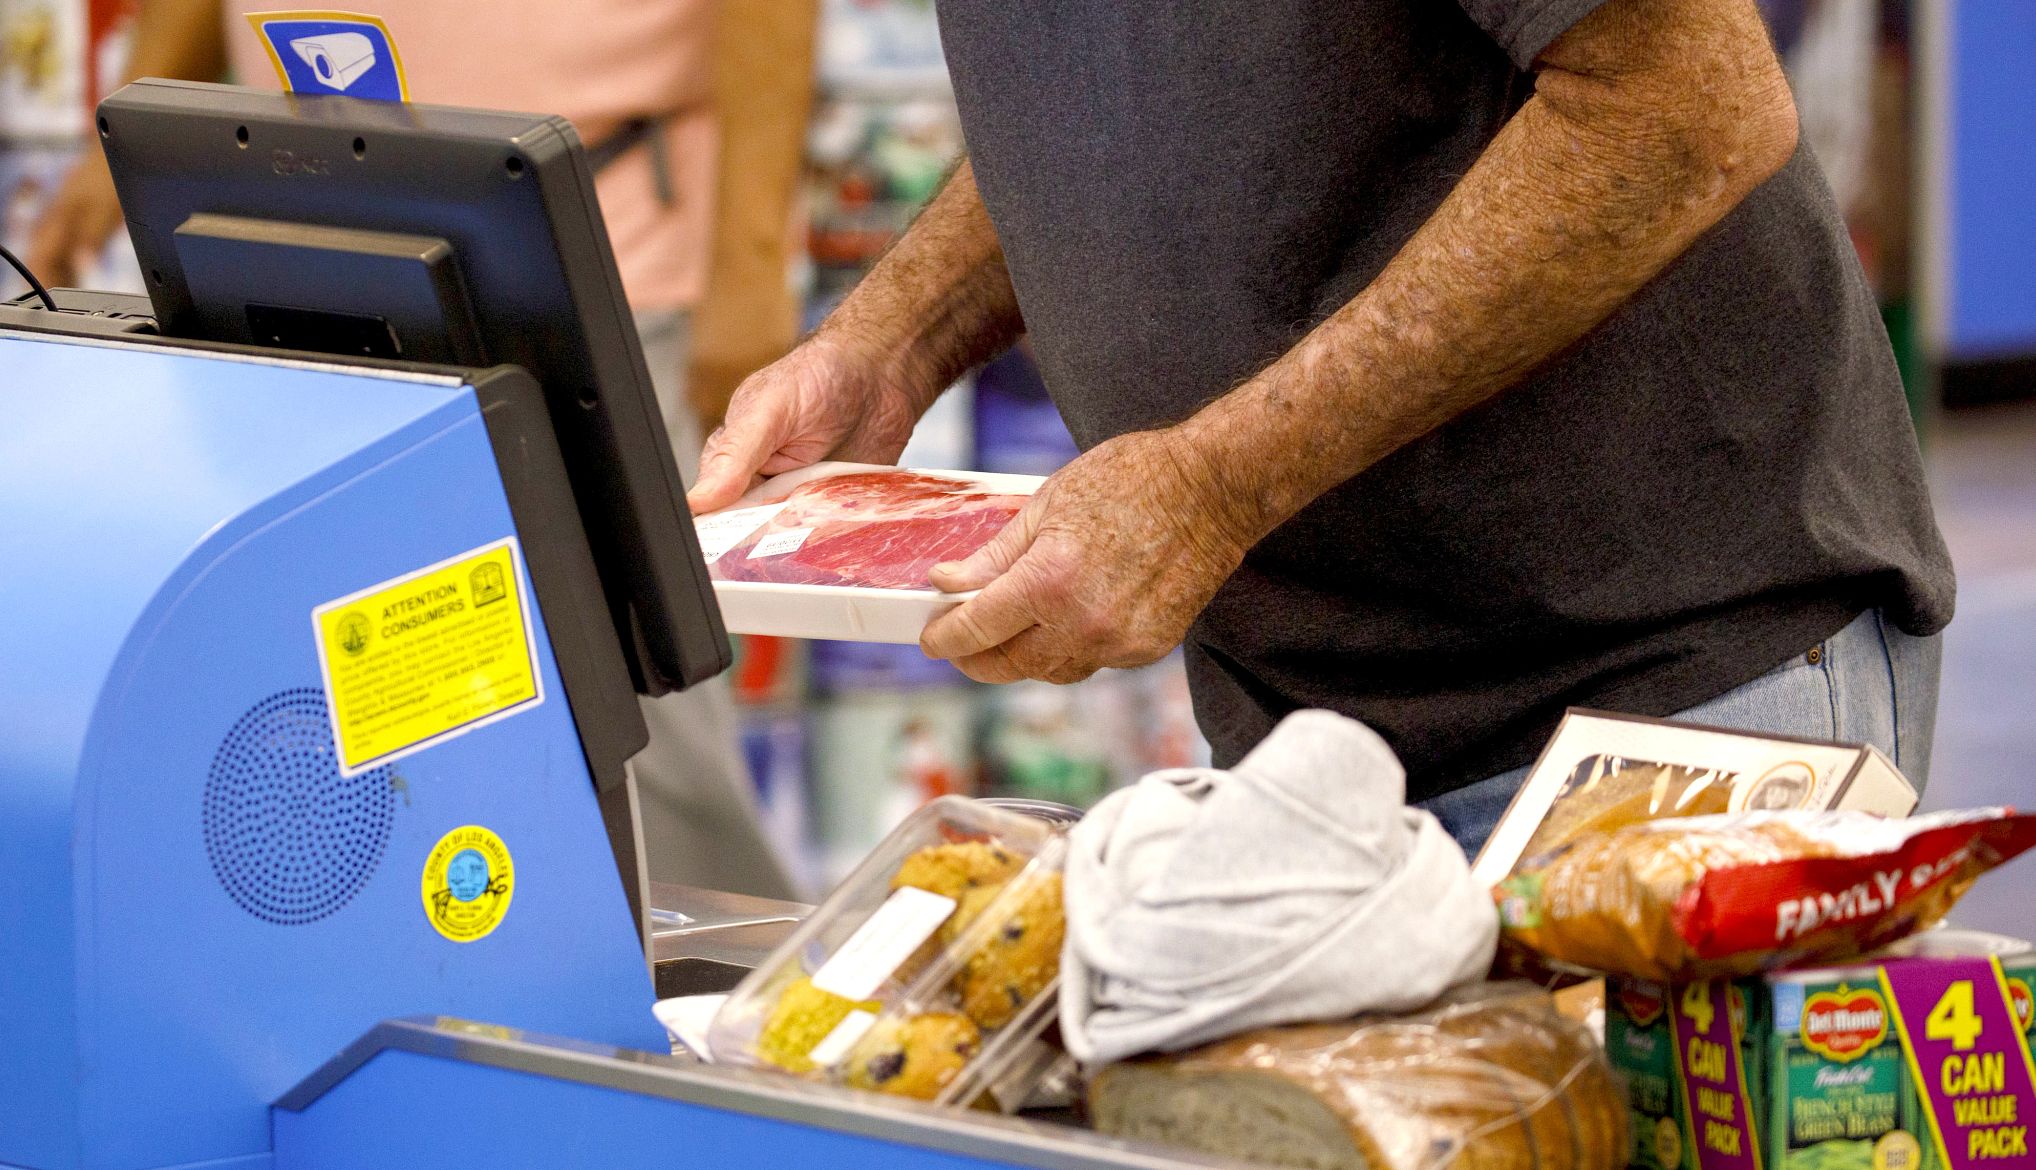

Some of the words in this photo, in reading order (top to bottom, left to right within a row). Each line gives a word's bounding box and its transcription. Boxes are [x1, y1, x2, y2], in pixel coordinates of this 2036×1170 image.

[380, 581, 457, 620] ATTENTION
[380, 597, 465, 639] CONSUMERS
[427, 841, 450, 880] COUNTY
[451, 832, 463, 845] OF
[466, 831, 483, 843] LOS
[485, 837, 508, 877] ANGELES
[1775, 868, 1902, 941] FAMILY
[1682, 979, 1714, 1034] 4
[1808, 1010, 1832, 1034] Del
[1834, 1008, 1883, 1032] Monte
[1926, 980, 1983, 1051] 4
[1688, 1036, 1727, 1085] CAN
[1941, 1052, 2005, 1097] CAN
[1696, 1087, 1735, 1122] VALUE
[1953, 1094, 2018, 1128] VALUE
[1705, 1119, 1742, 1157] PACK
[1968, 1125, 2028, 1160] PACK
